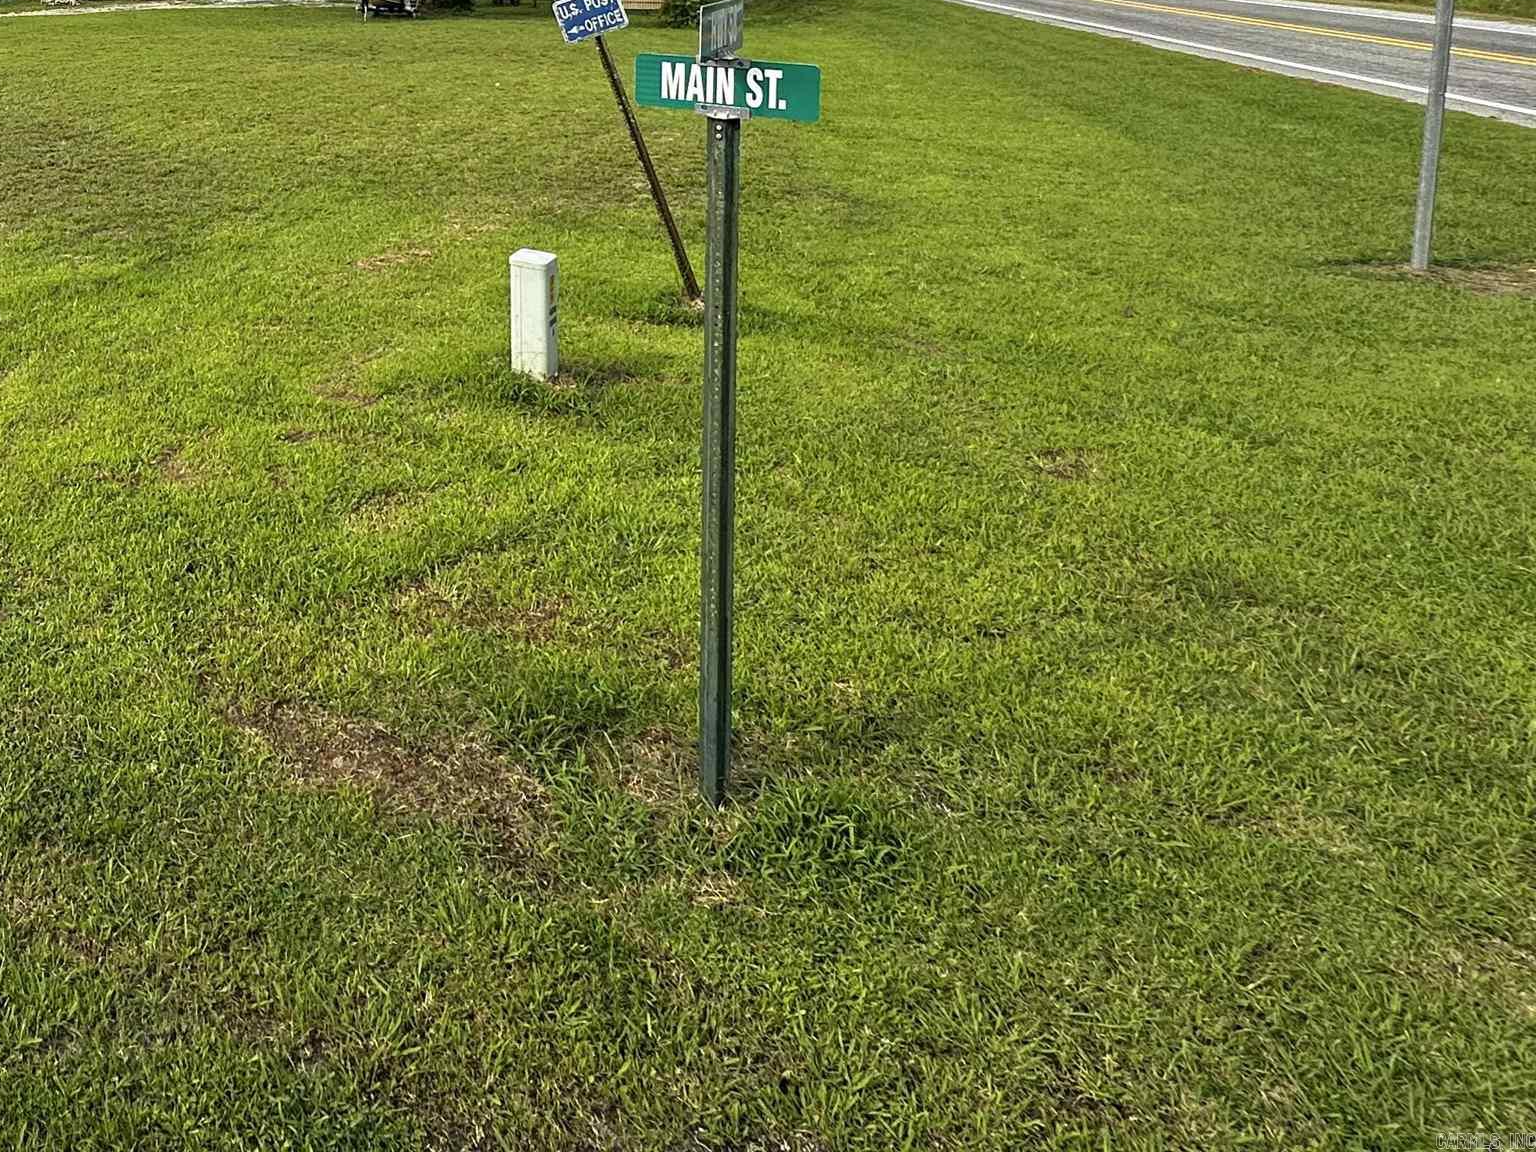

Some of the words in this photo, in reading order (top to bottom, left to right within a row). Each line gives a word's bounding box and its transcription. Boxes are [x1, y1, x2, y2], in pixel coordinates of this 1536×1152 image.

[558, 3, 583, 20] U.S.
[584, 9, 624, 32] OFFICE
[661, 61, 735, 105] MAIN
[745, 67, 787, 110] ST.
